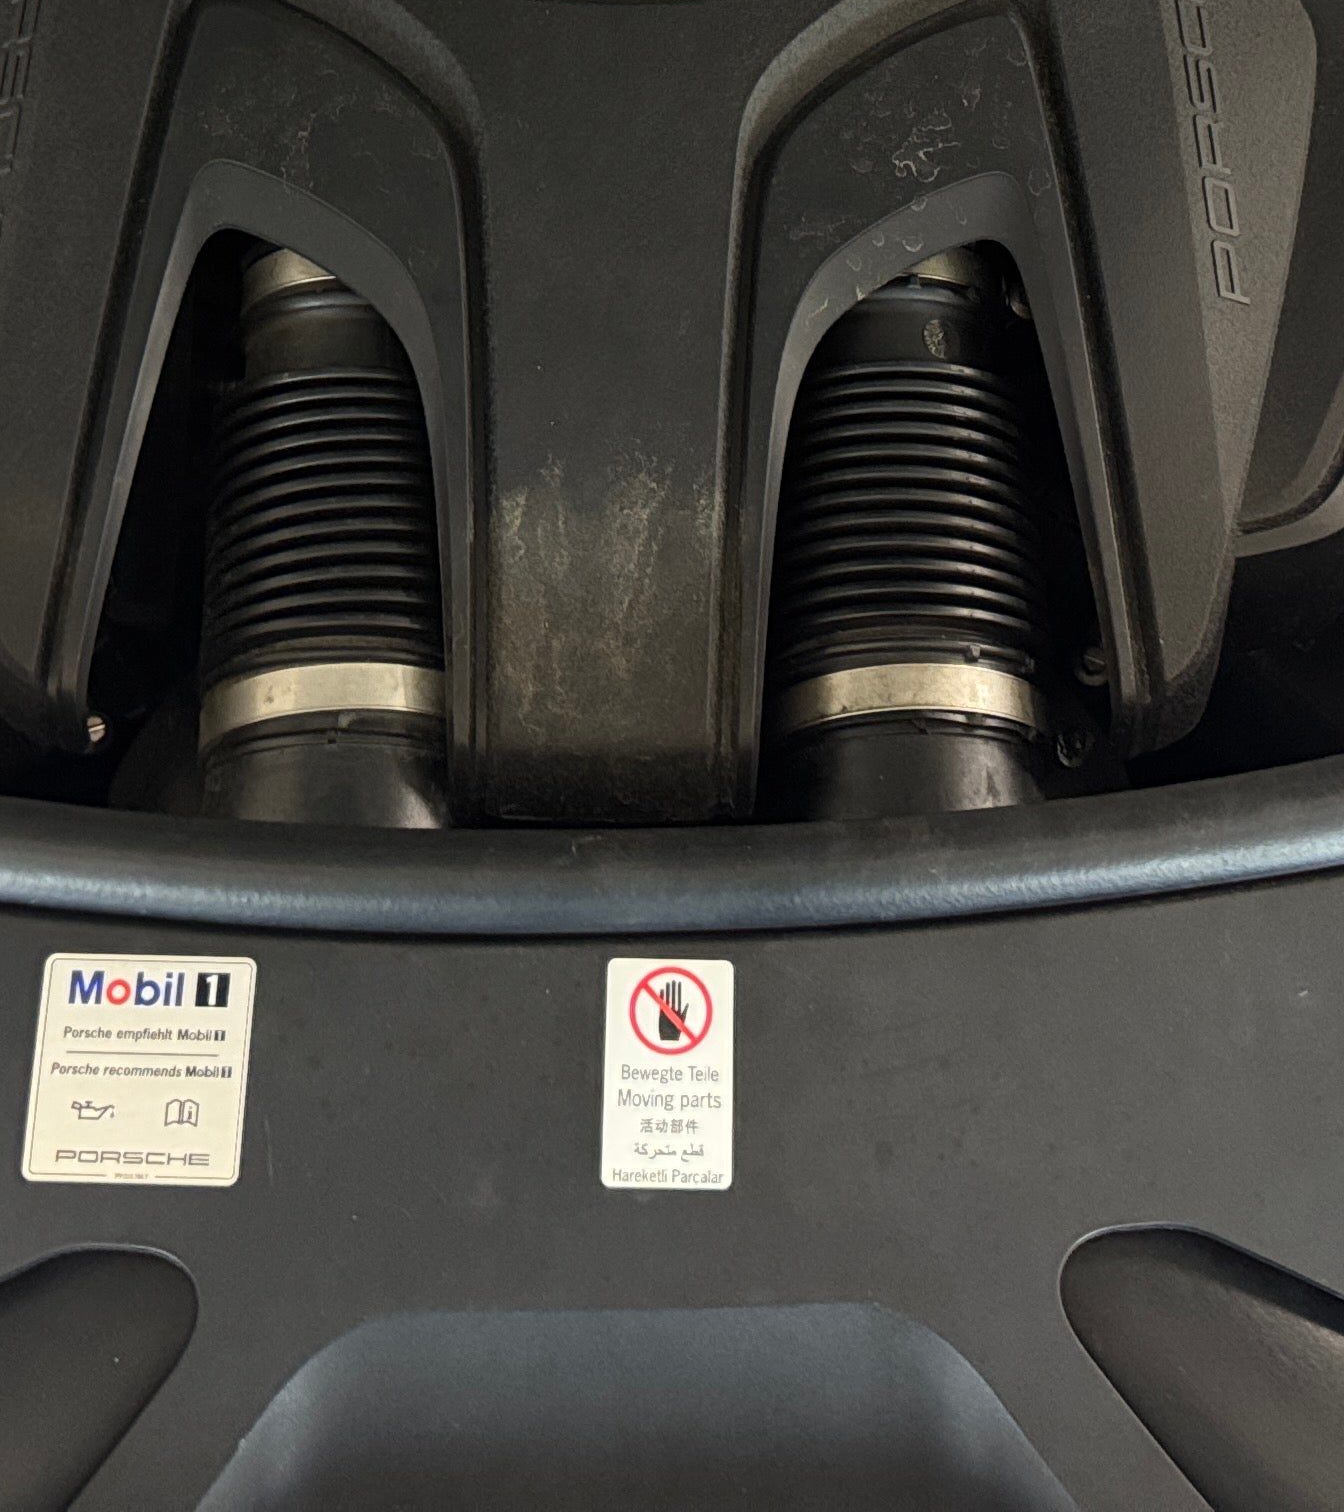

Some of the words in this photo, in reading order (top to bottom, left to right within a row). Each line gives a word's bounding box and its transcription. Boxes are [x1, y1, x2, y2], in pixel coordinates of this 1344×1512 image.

[68, 970, 185, 1006] Mobil
[63, 1026, 112, 1039] Porsche
[116, 1027, 172, 1042] empfiehlt
[50, 1062, 100, 1075] Porsche
[103, 1064, 182, 1078] recommends
[621, 1063, 683, 1084] Bewegte
[688, 1066, 719, 1082] Teile
[617, 1089, 674, 1111] Moving
[680, 1092, 722, 1110] parts
[640, 1118, 699, 1135] 活动部件
[55, 1149, 210, 1166] PORSCHE
[680, 1142, 704, 1163] قطع
[612, 1168, 668, 1183] Hareketli
[671, 1169, 724, 1185] Parçalar
